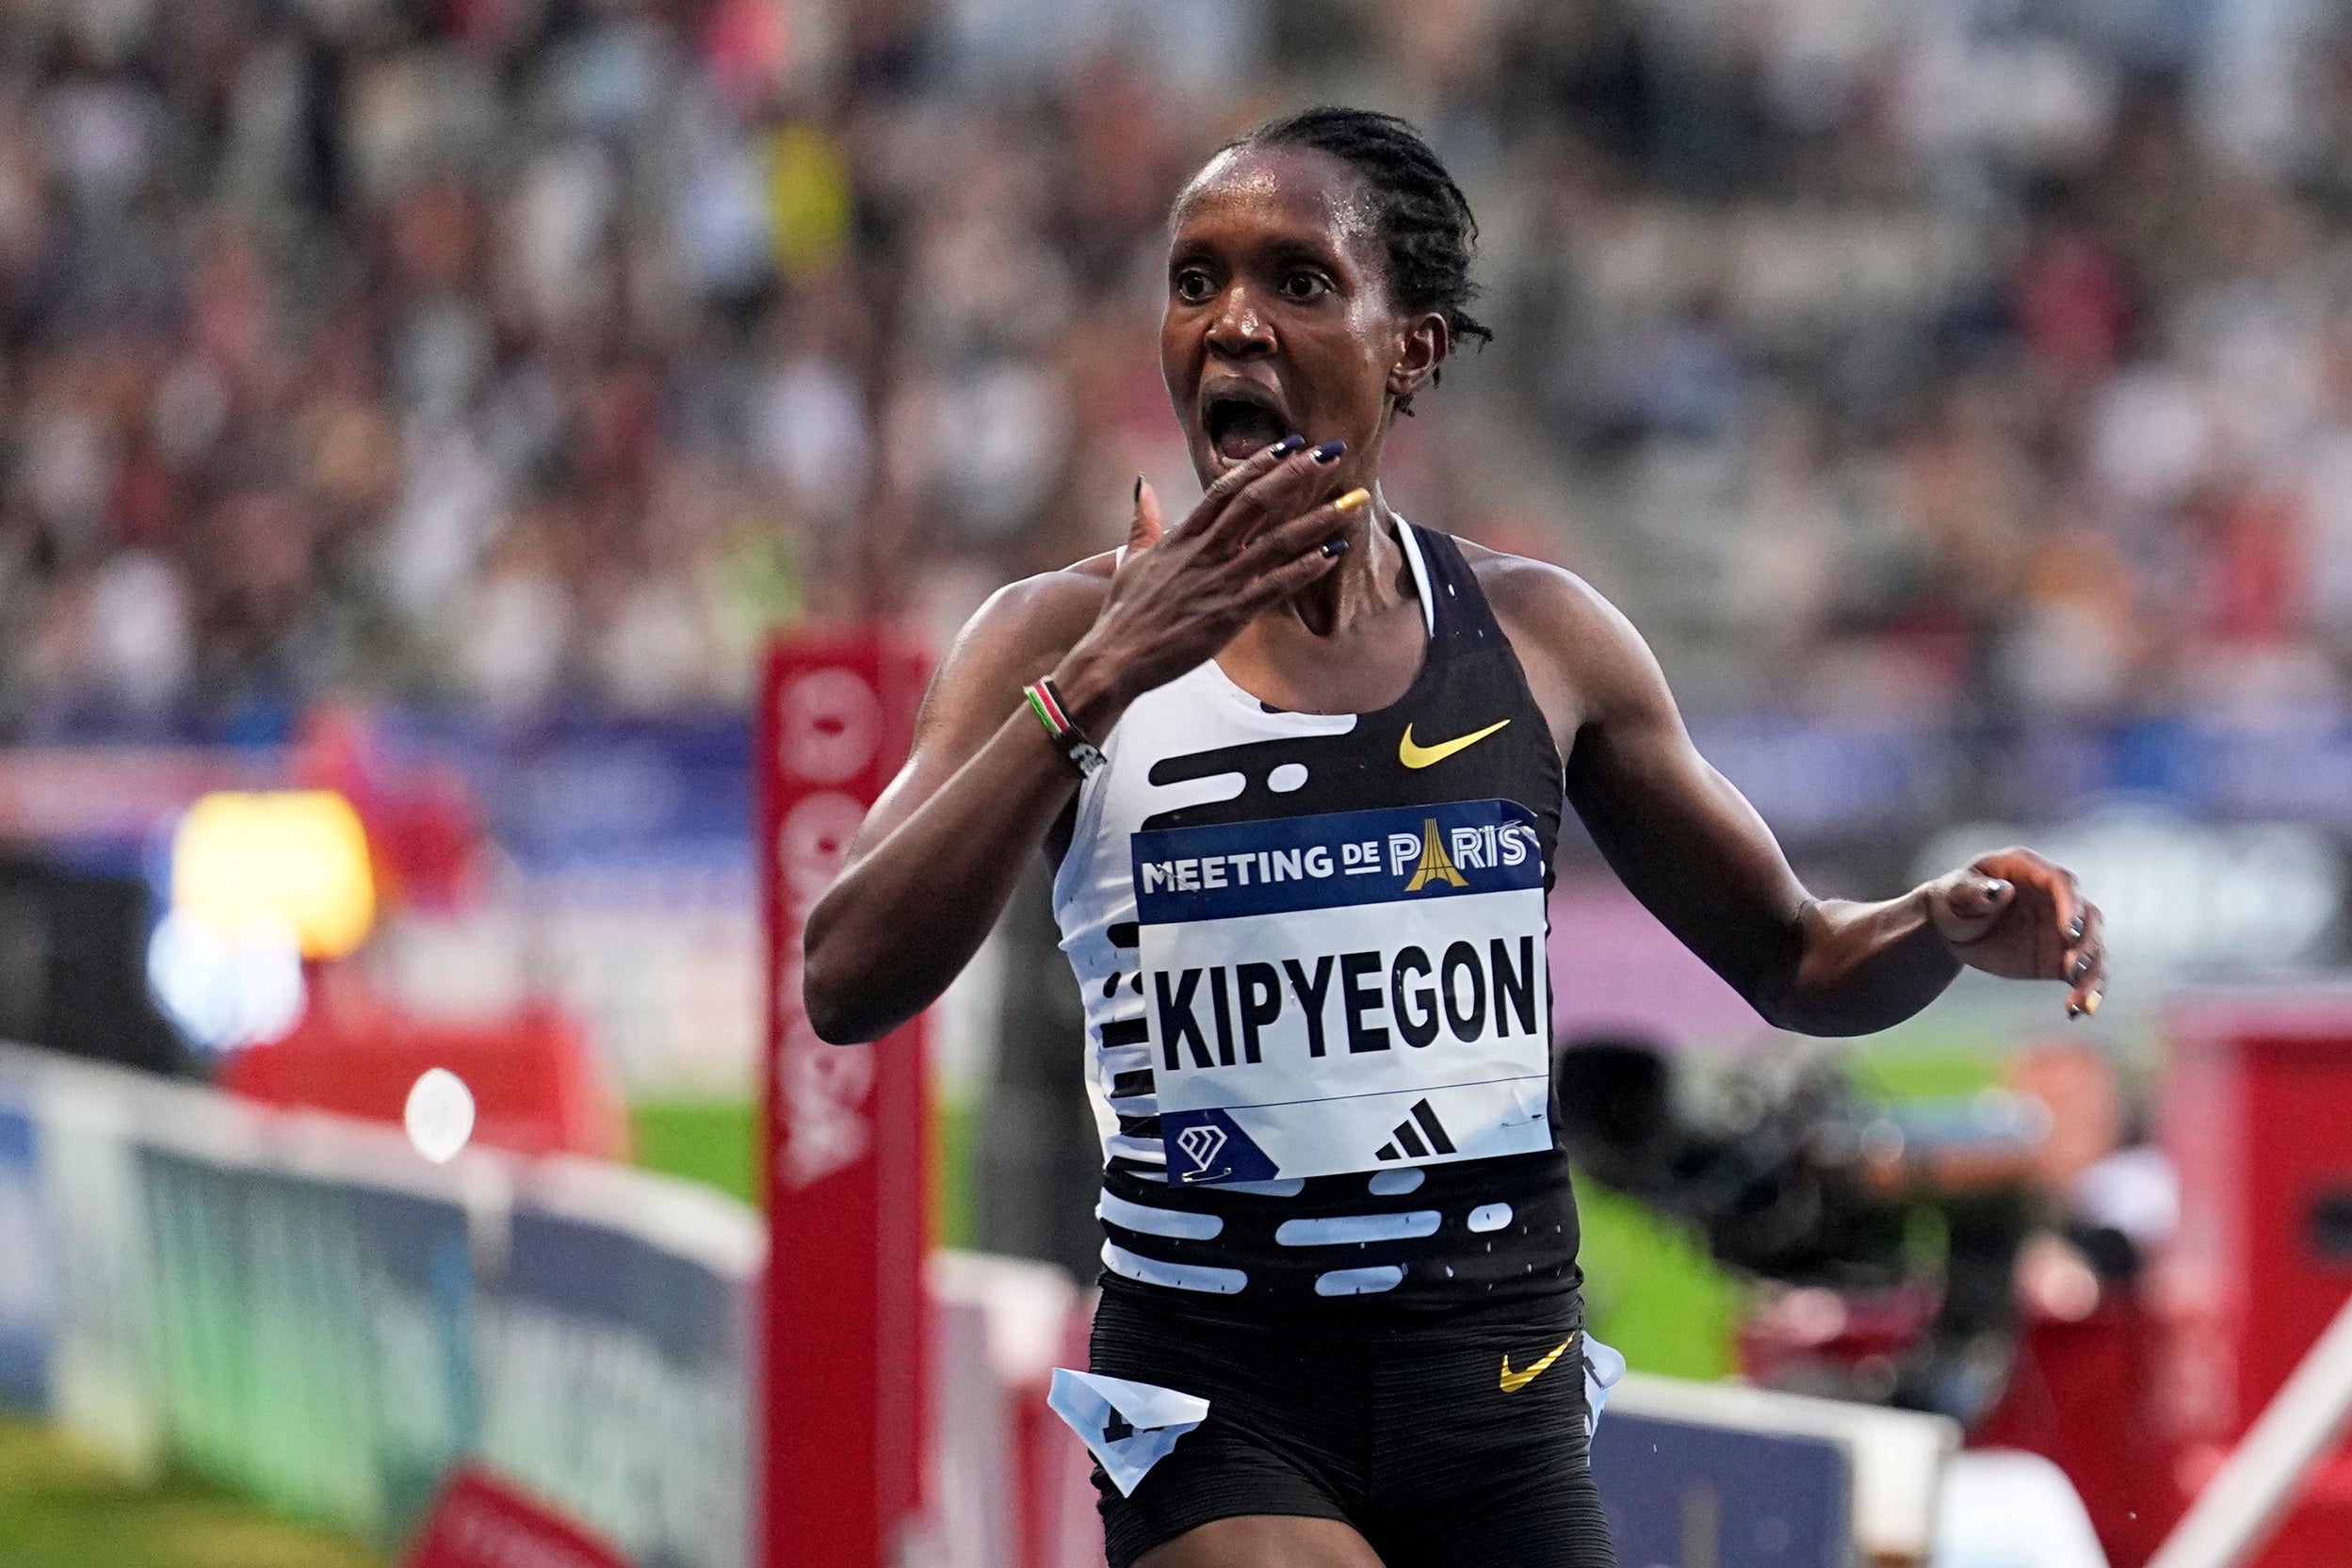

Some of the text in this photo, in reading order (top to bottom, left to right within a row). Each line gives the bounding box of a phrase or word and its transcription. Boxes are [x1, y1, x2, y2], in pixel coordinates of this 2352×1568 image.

[1142, 818, 1527, 894] MEETING DE PARIS
[1155, 936, 1537, 1071] KIPYEGON
